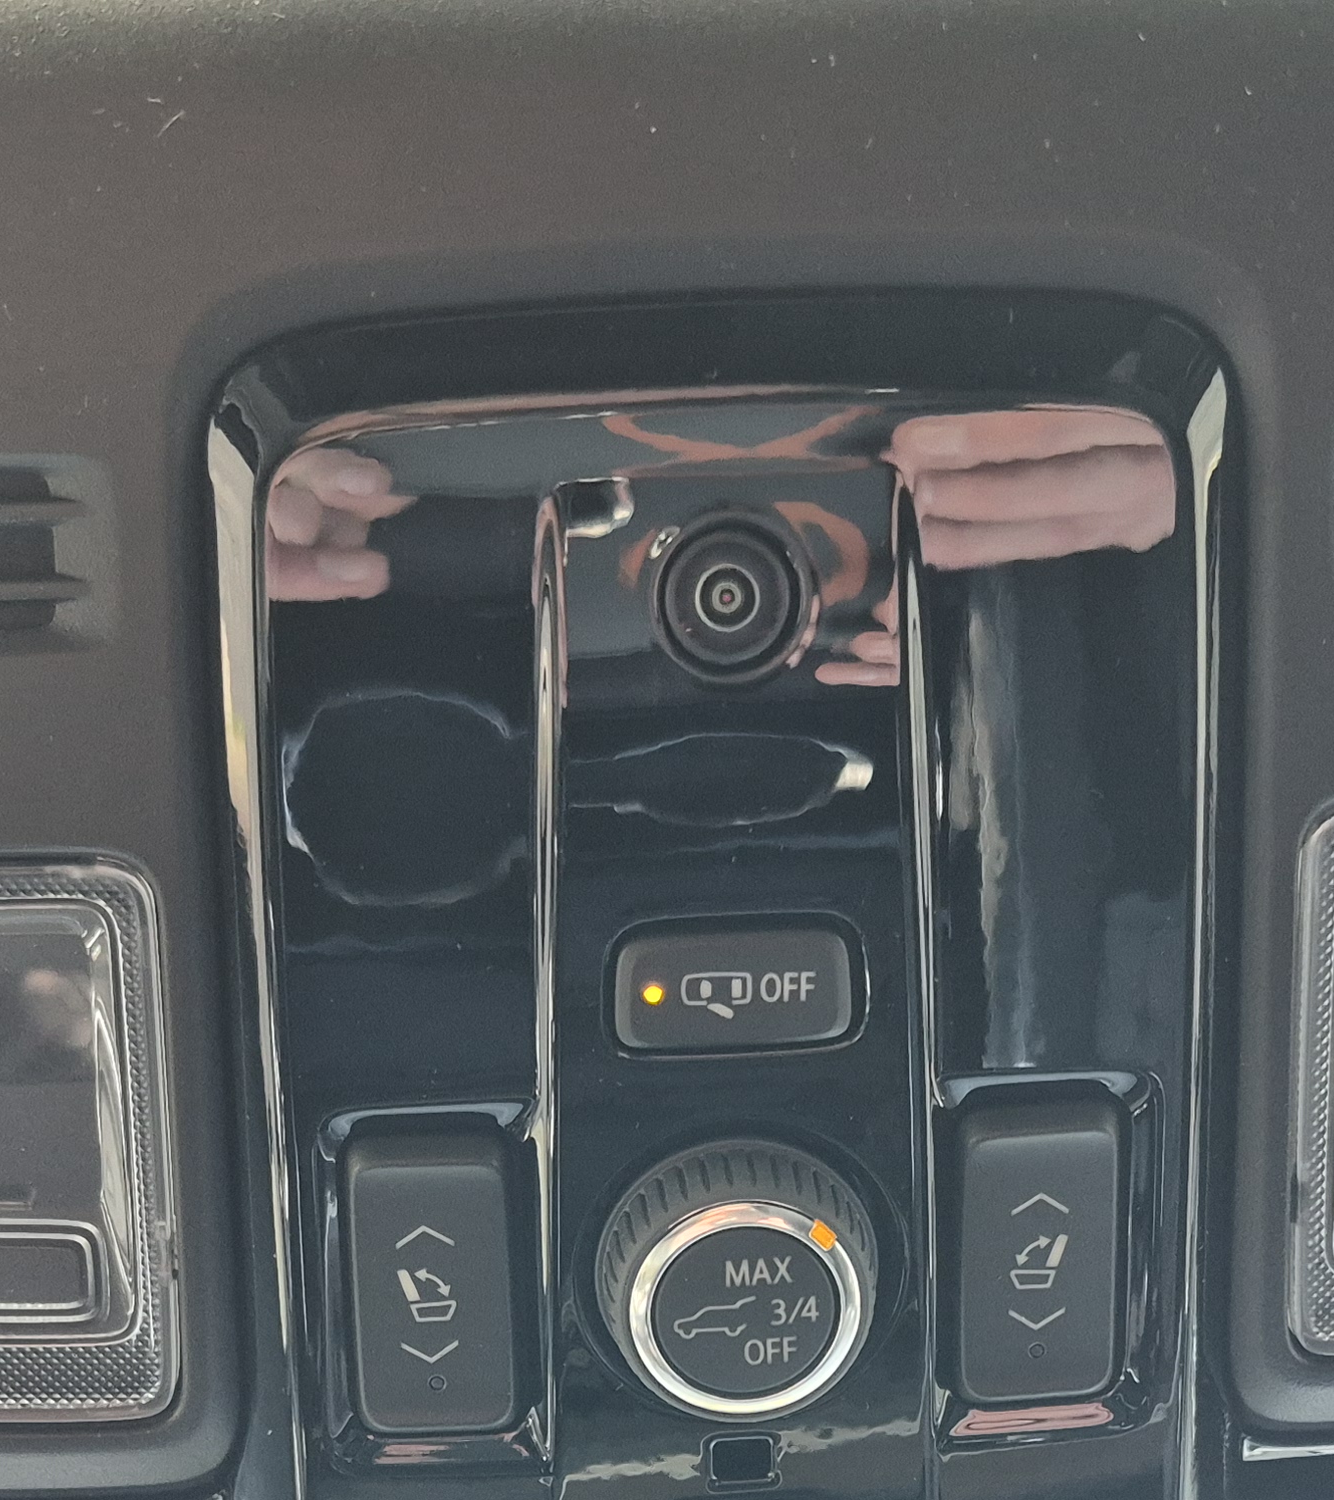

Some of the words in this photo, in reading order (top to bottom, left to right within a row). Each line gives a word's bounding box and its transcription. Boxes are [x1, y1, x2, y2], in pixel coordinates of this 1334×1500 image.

[760, 971, 816, 1003] OFF
[725, 1256, 793, 1287] MAX
[771, 1296, 819, 1326] 3/4
[744, 1336, 798, 1365] OFF
